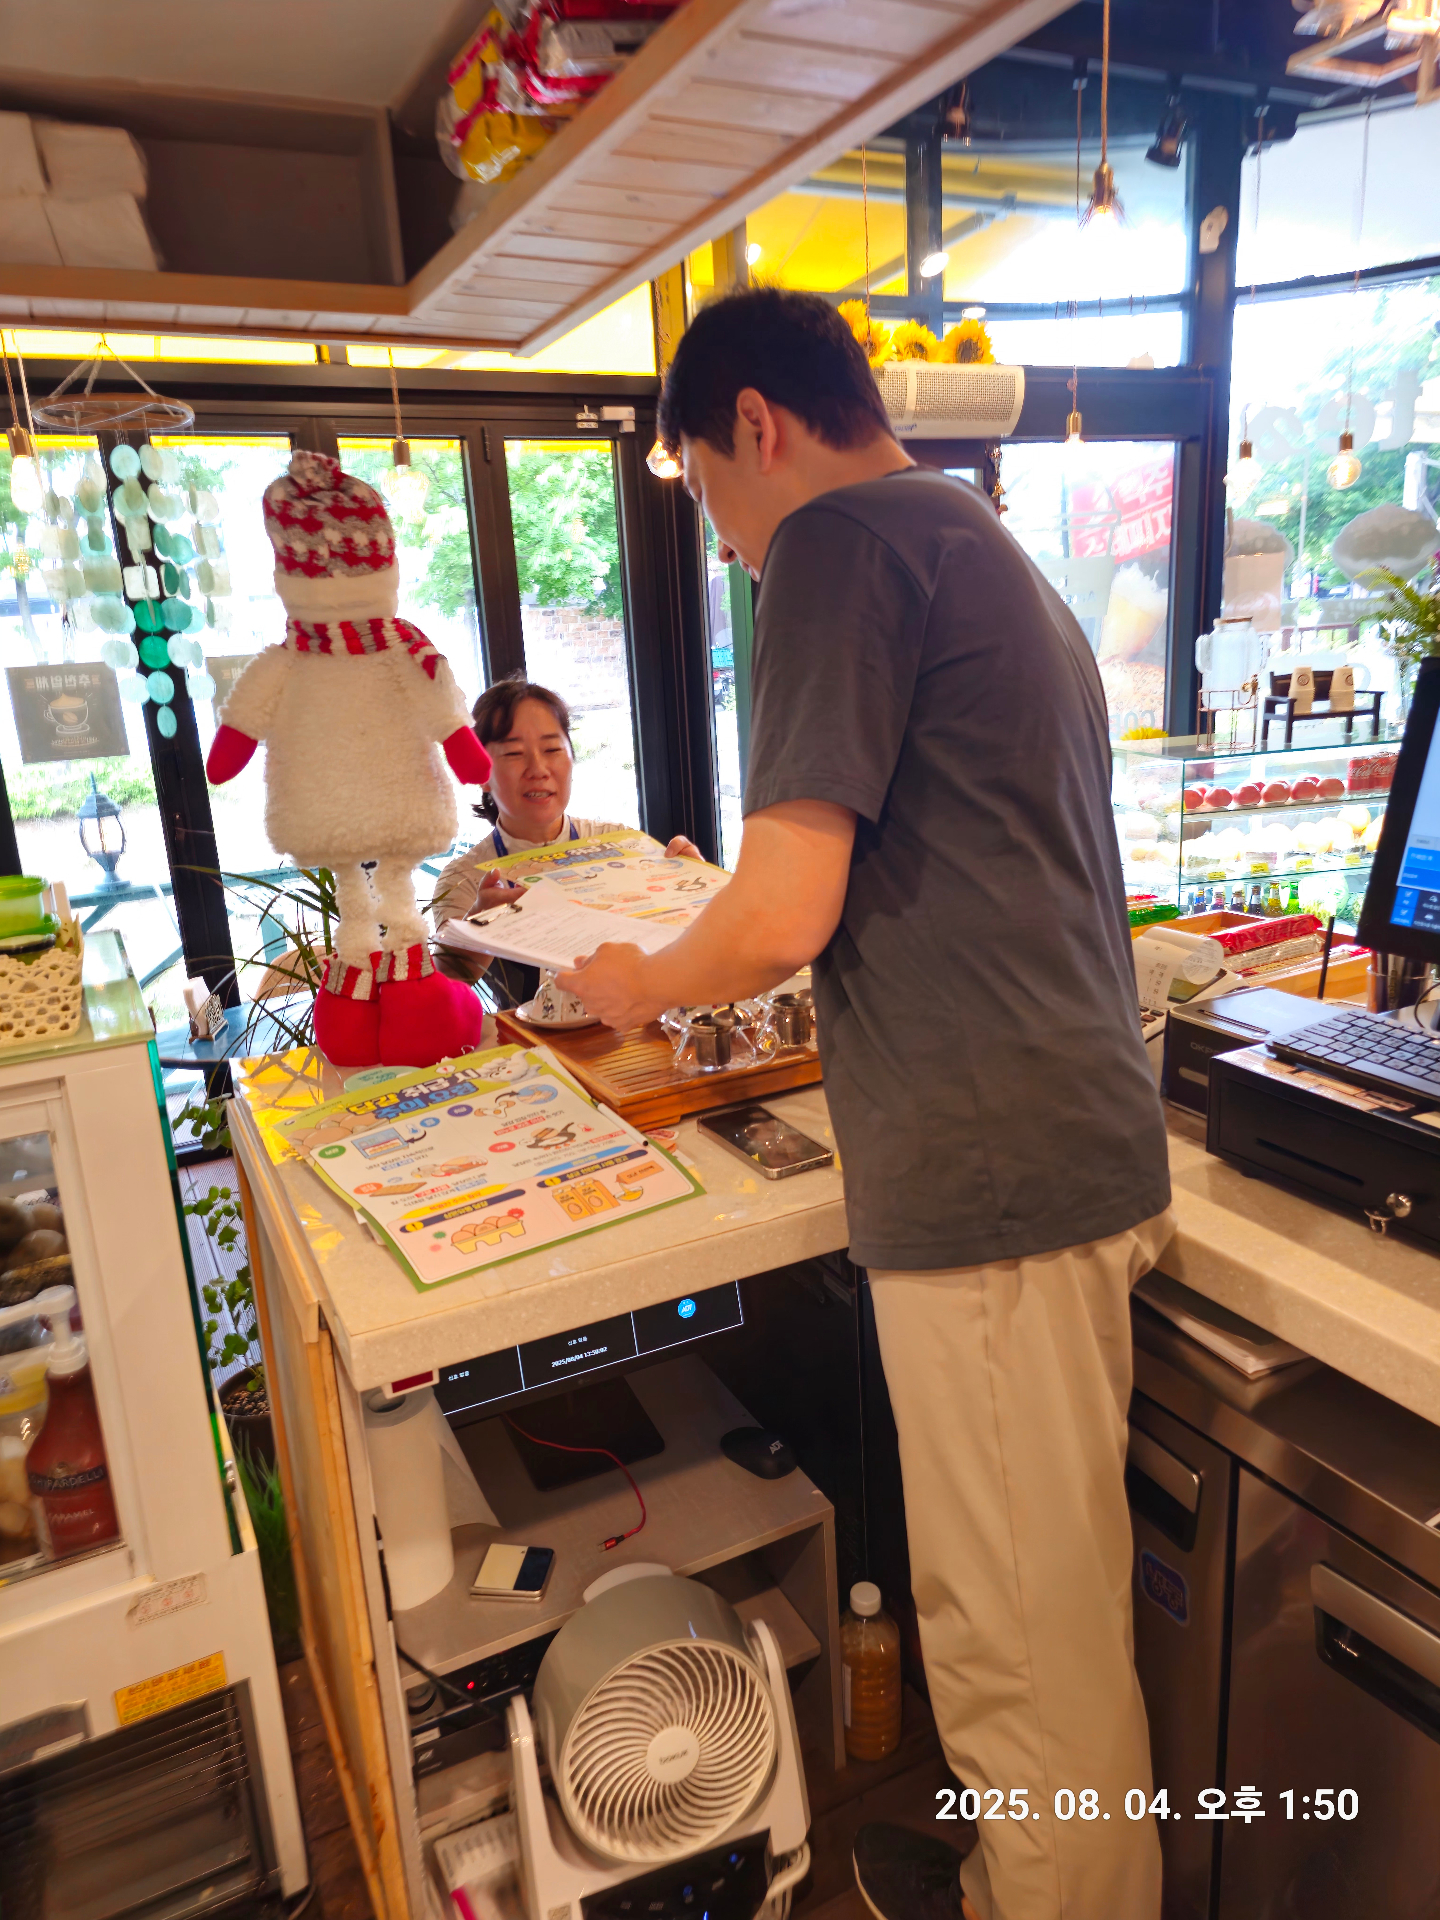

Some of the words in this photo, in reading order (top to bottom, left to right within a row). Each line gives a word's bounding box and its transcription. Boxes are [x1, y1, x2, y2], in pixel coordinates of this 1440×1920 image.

[348, 1092, 401, 1116] 달걀
[401, 1078, 451, 1098] 취급
[455, 1067, 482, 1083] 시
[375, 1098, 428, 1119] 주의
